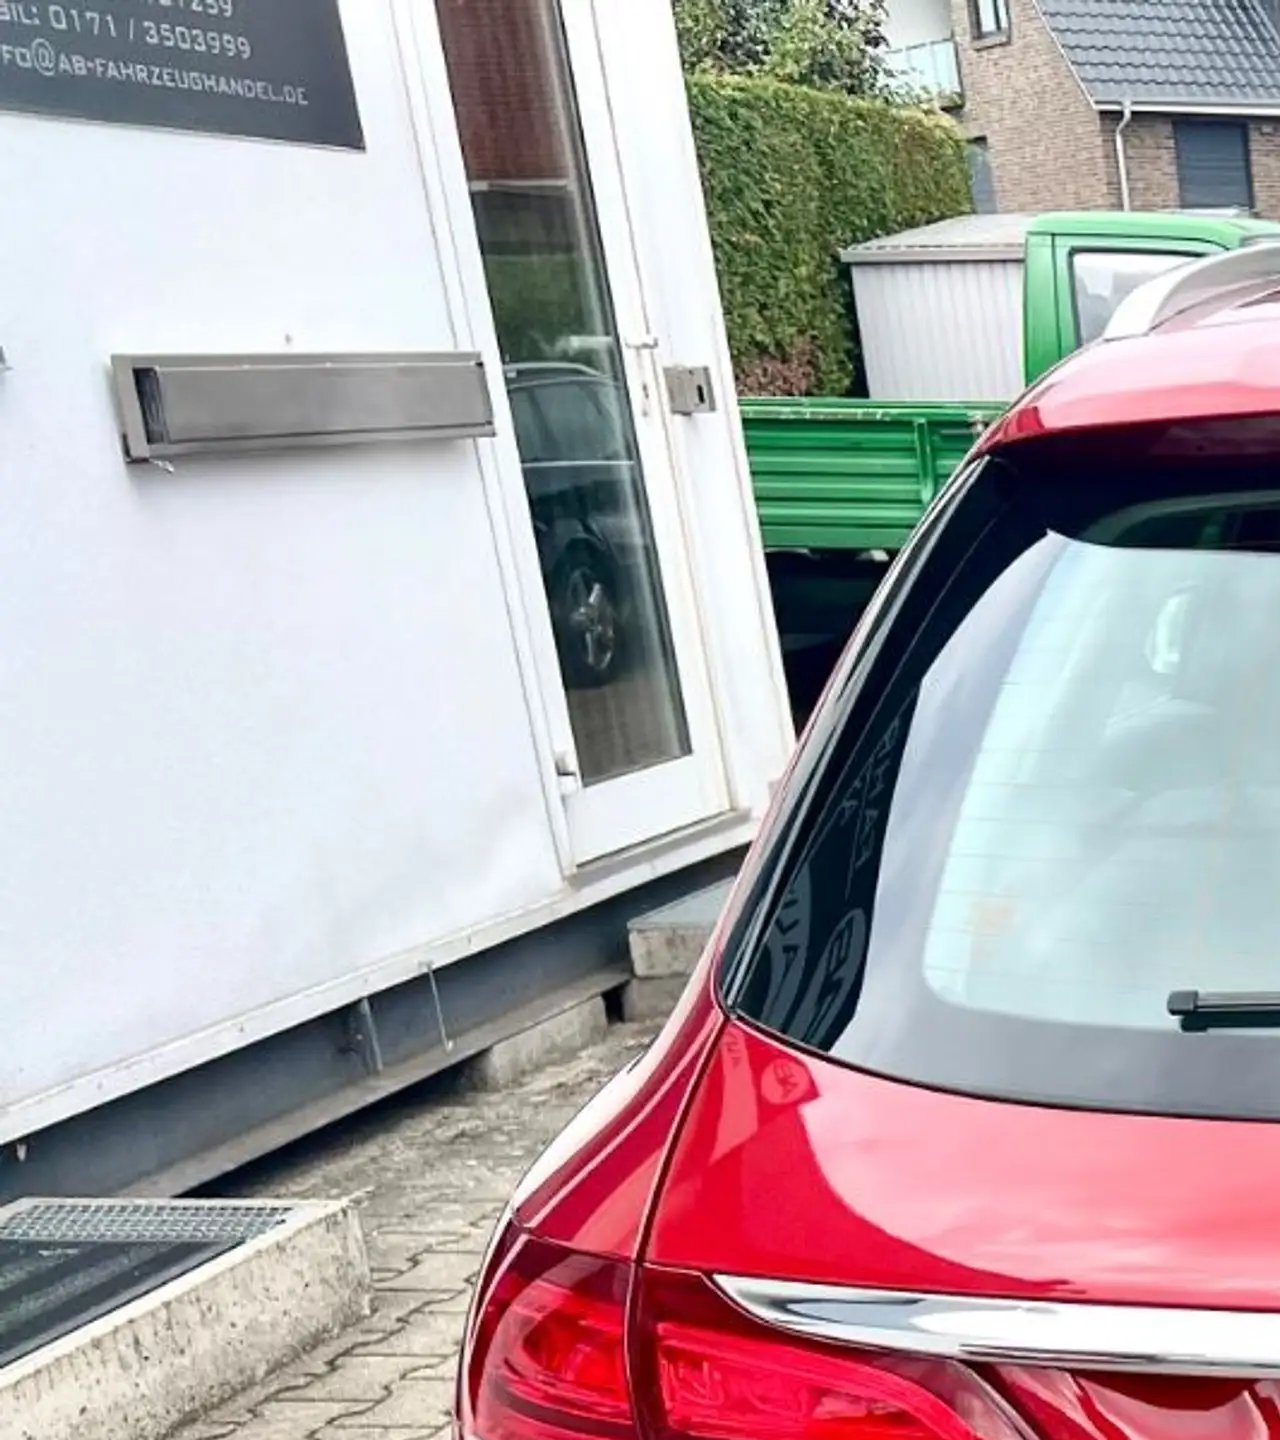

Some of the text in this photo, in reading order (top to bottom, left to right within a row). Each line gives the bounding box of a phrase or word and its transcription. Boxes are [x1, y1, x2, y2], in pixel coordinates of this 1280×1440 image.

[48, 4, 117, 38] 0171
[129, 18, 135, 41] /
[142, 20, 251, 59] 3503999
